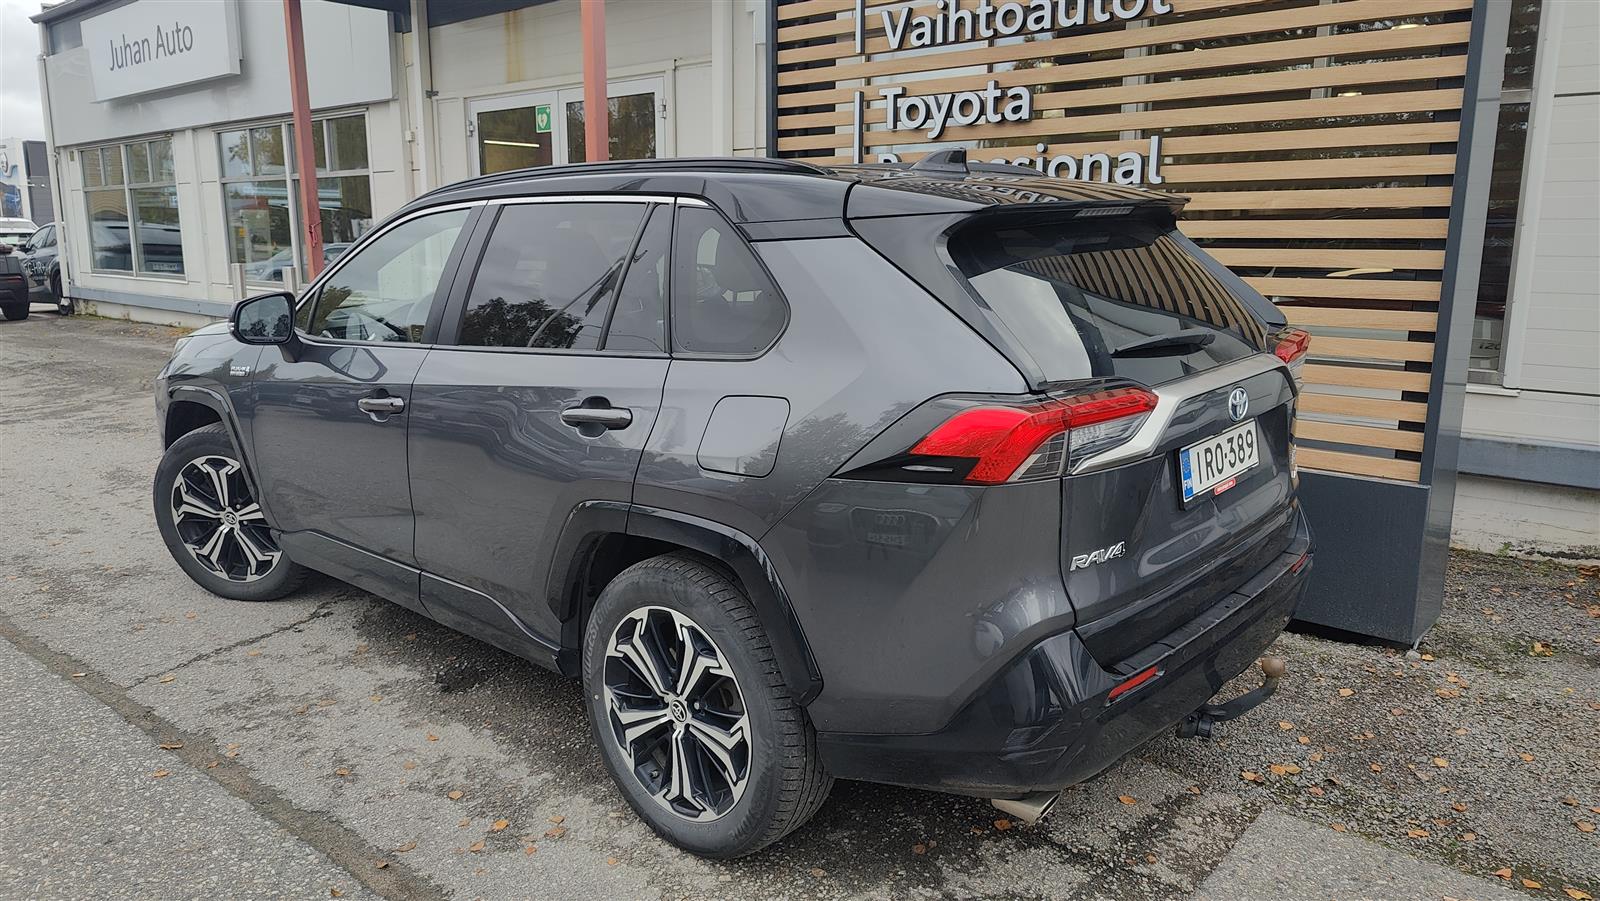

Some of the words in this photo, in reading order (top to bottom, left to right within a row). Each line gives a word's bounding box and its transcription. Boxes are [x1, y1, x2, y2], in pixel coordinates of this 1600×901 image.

[110, 33, 152, 71] Juhan
[156, 21, 193, 59] Auto
[879, 80, 1031, 139] Toyota
[1196, 429, 1254, 485] IRO-389
[1070, 541, 1126, 571] RAV4
